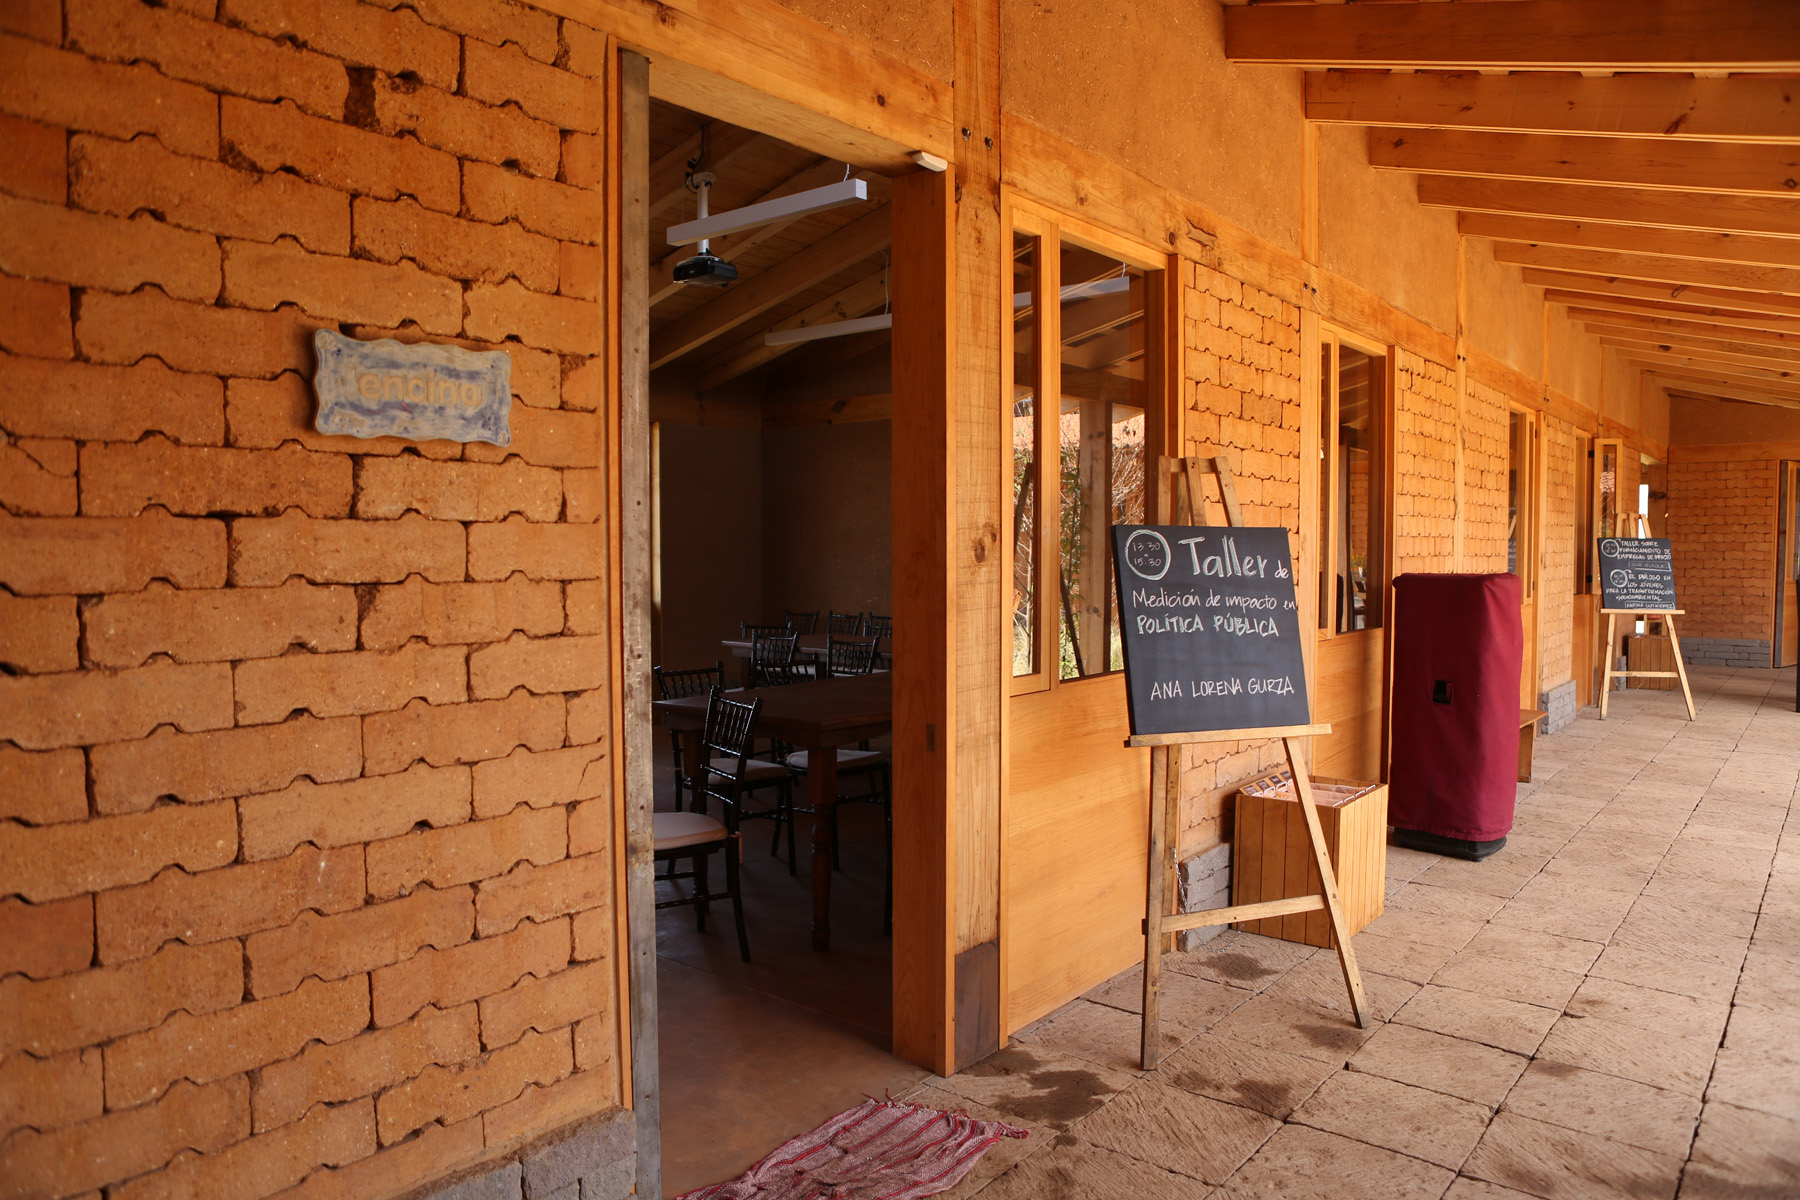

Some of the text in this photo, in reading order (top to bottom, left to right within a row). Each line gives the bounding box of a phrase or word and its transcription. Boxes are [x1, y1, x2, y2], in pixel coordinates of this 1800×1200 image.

[358, 369, 482, 407] encino
[1178, 535, 1290, 579] Taller de
[1132, 588, 1296, 614] Medición de impacto en
[1136, 612, 1280, 637] POLÍTICA PÚBLICA
[1150, 680, 1183, 701] ANA
[1191, 677, 1243, 698] LORENA
